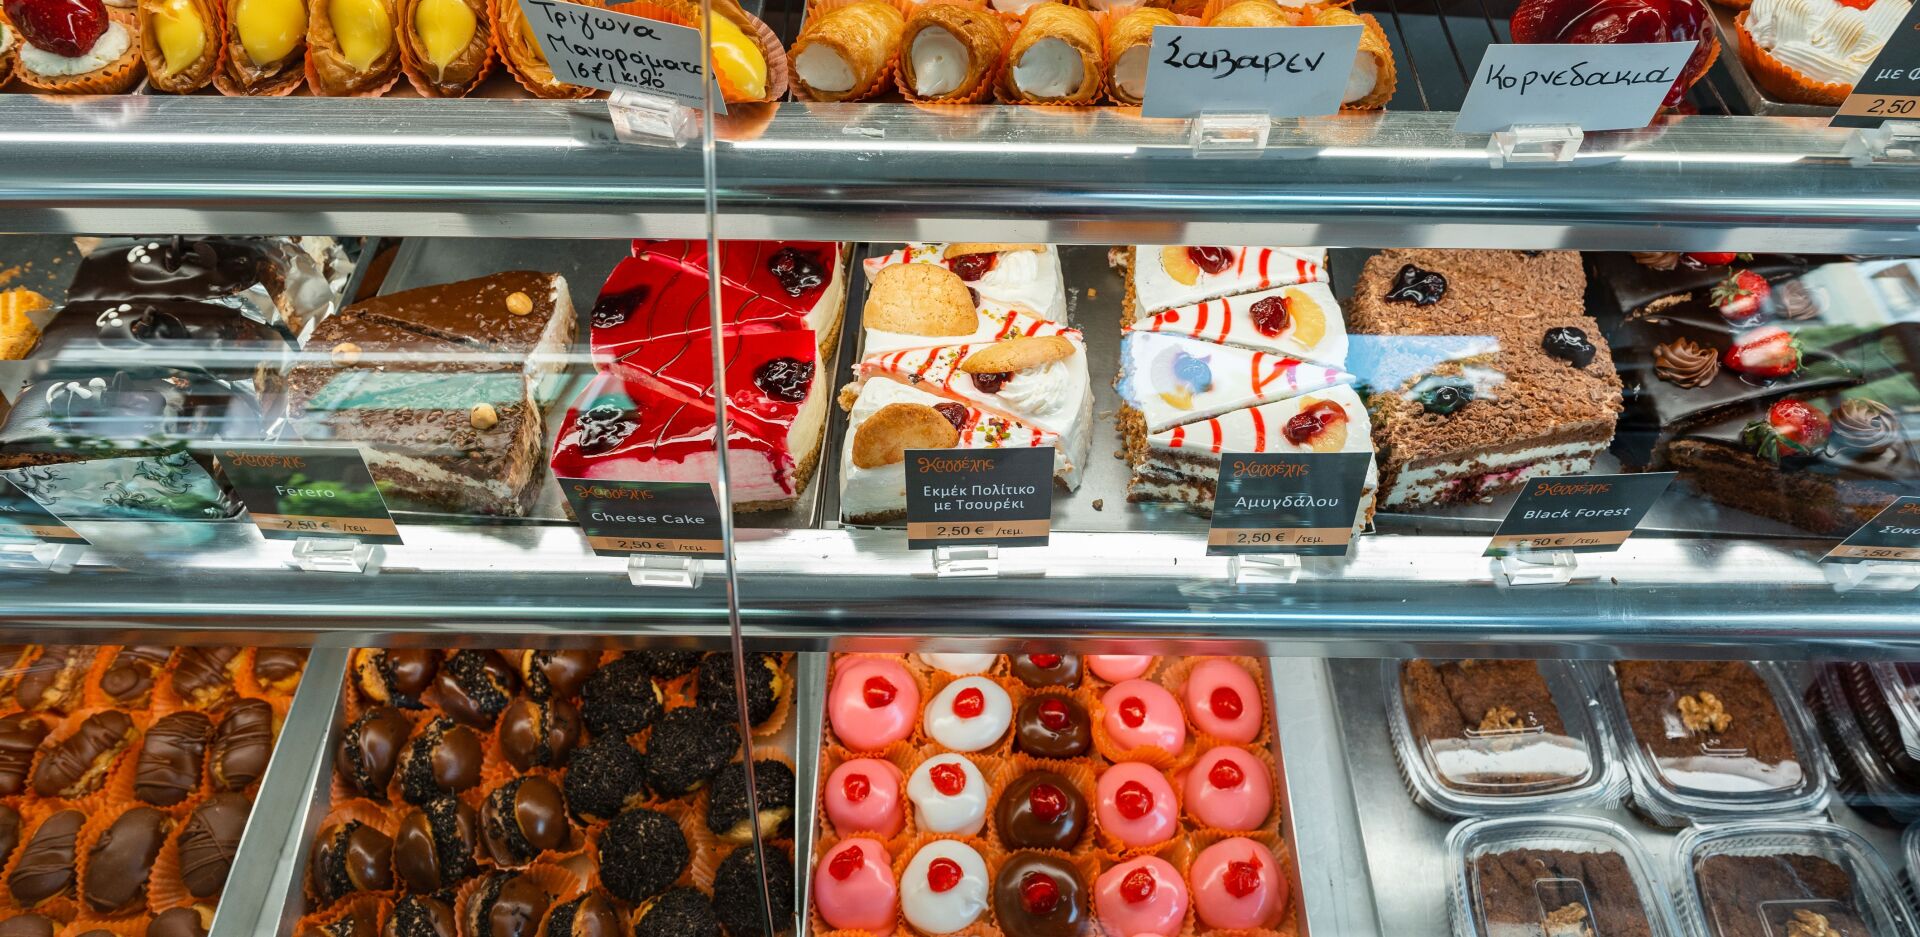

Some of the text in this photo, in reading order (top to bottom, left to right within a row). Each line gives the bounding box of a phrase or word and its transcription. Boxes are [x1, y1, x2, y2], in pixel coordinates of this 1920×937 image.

[1874, 68, 1904, 81] με
[1867, 99, 1916, 115] 2,50
[275, 485, 335, 498] Ferero
[923, 484, 1035, 498] Εκμέκ Πολίτικο
[934, 499, 1024, 512] με Τσουρέκι
[1235, 495, 1338, 509] Αμυγδάλου
[591, 512, 705, 525] Cheese Cake
[1523, 507, 1631, 520] Black Forest
[283, 520, 317, 531] 2,50
[320, 522, 333, 531] €
[937, 526, 970, 537] 2,50
[975, 526, 984, 535] €
[1237, 533, 1271, 544] 2,50
[1275, 532, 1285, 542] €
[1555, 537, 1565, 545] €
[617, 540, 651, 550] 2,50
[655, 542, 666, 550] €
